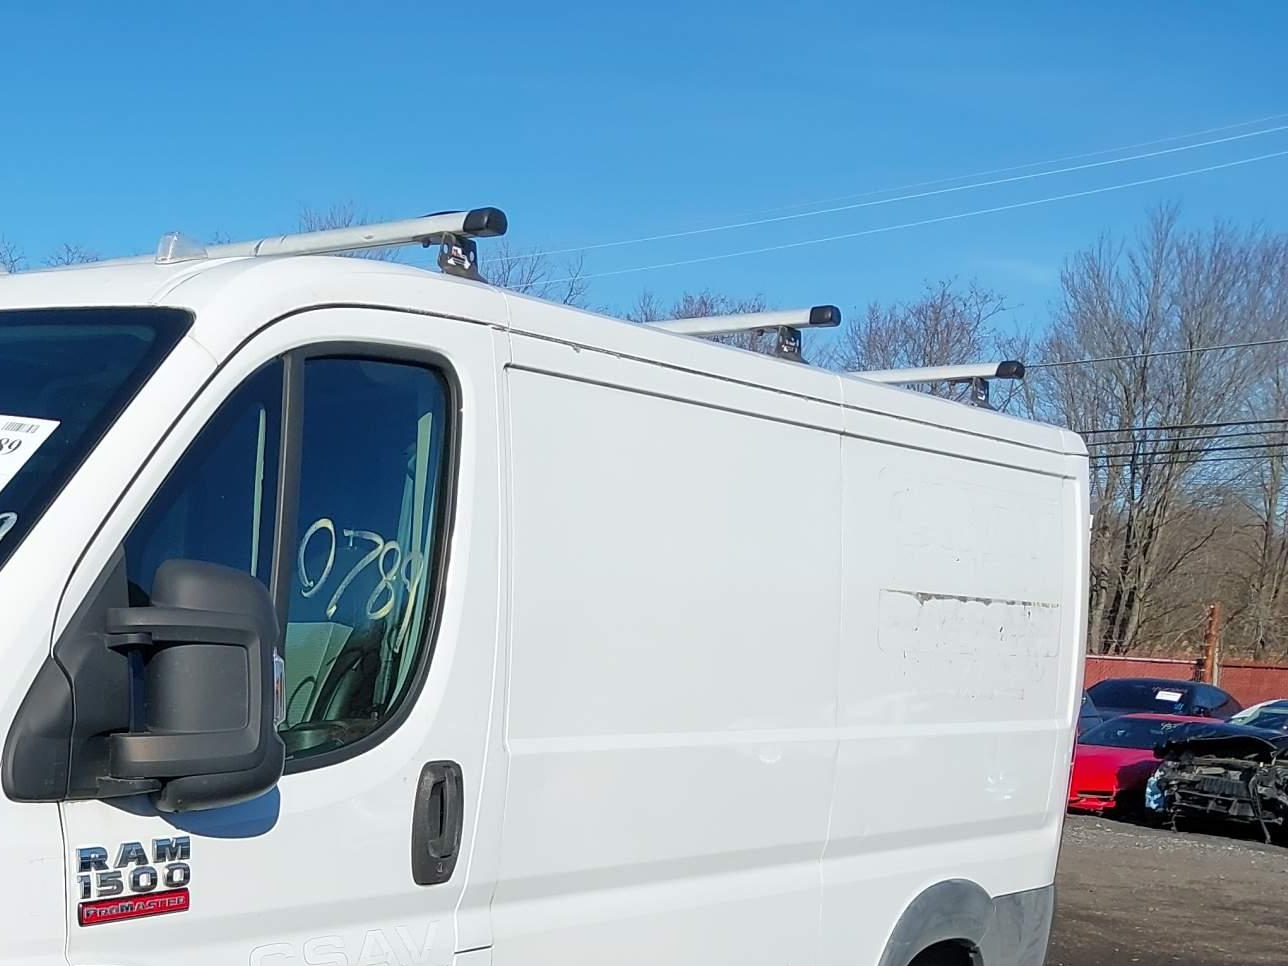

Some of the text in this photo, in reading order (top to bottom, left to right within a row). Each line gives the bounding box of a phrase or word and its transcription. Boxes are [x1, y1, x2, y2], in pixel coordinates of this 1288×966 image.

[298, 518, 424, 654] 0789
[75, 835, 191, 873] RAM
[77, 862, 191, 900] 1500
